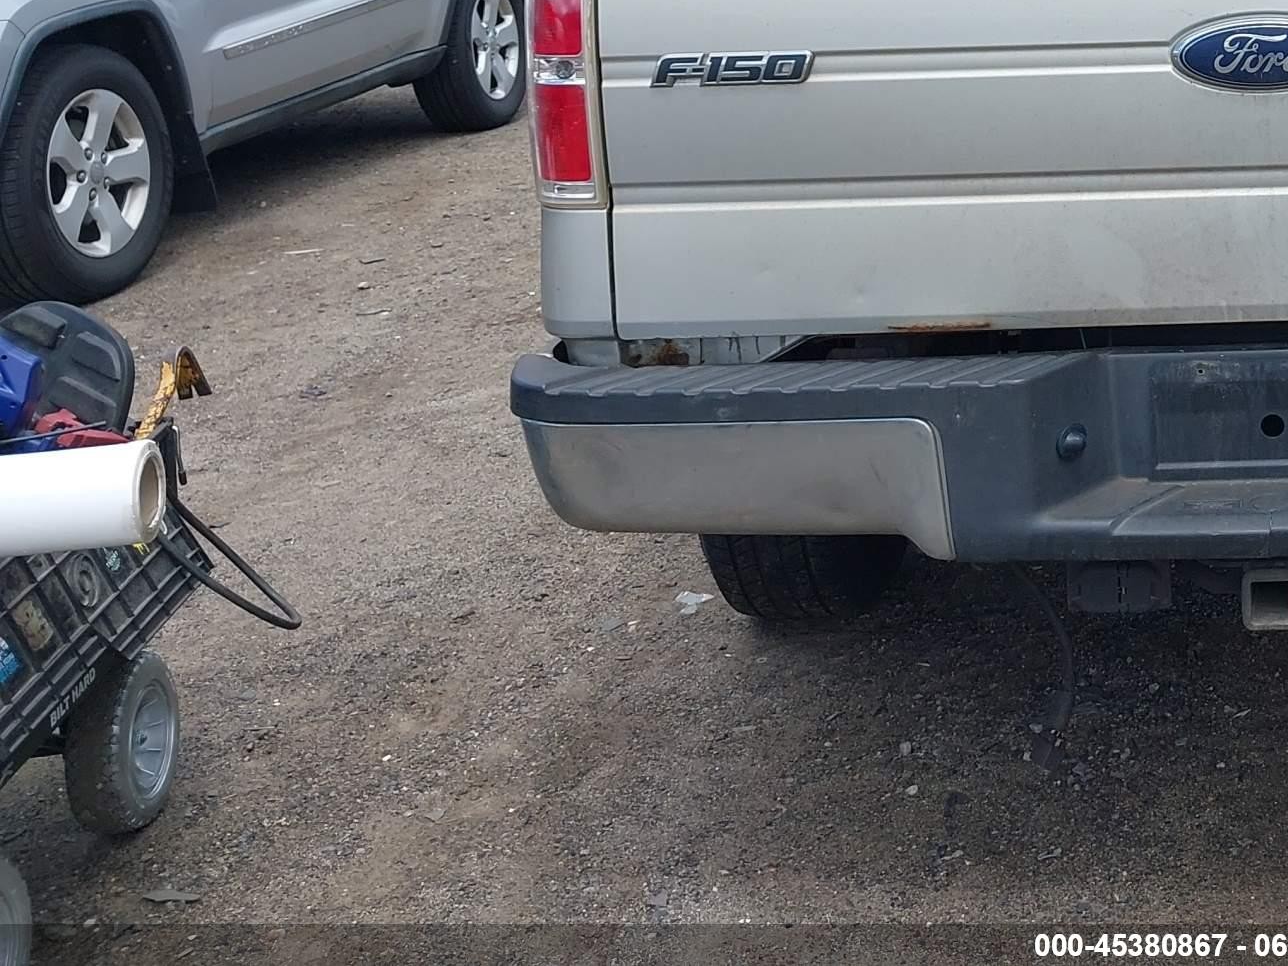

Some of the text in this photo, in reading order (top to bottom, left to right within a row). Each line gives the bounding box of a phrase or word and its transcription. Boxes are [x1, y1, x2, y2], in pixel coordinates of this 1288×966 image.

[650, 49, 816, 88] F-150
[50, 666, 96, 729] BILT HARD
